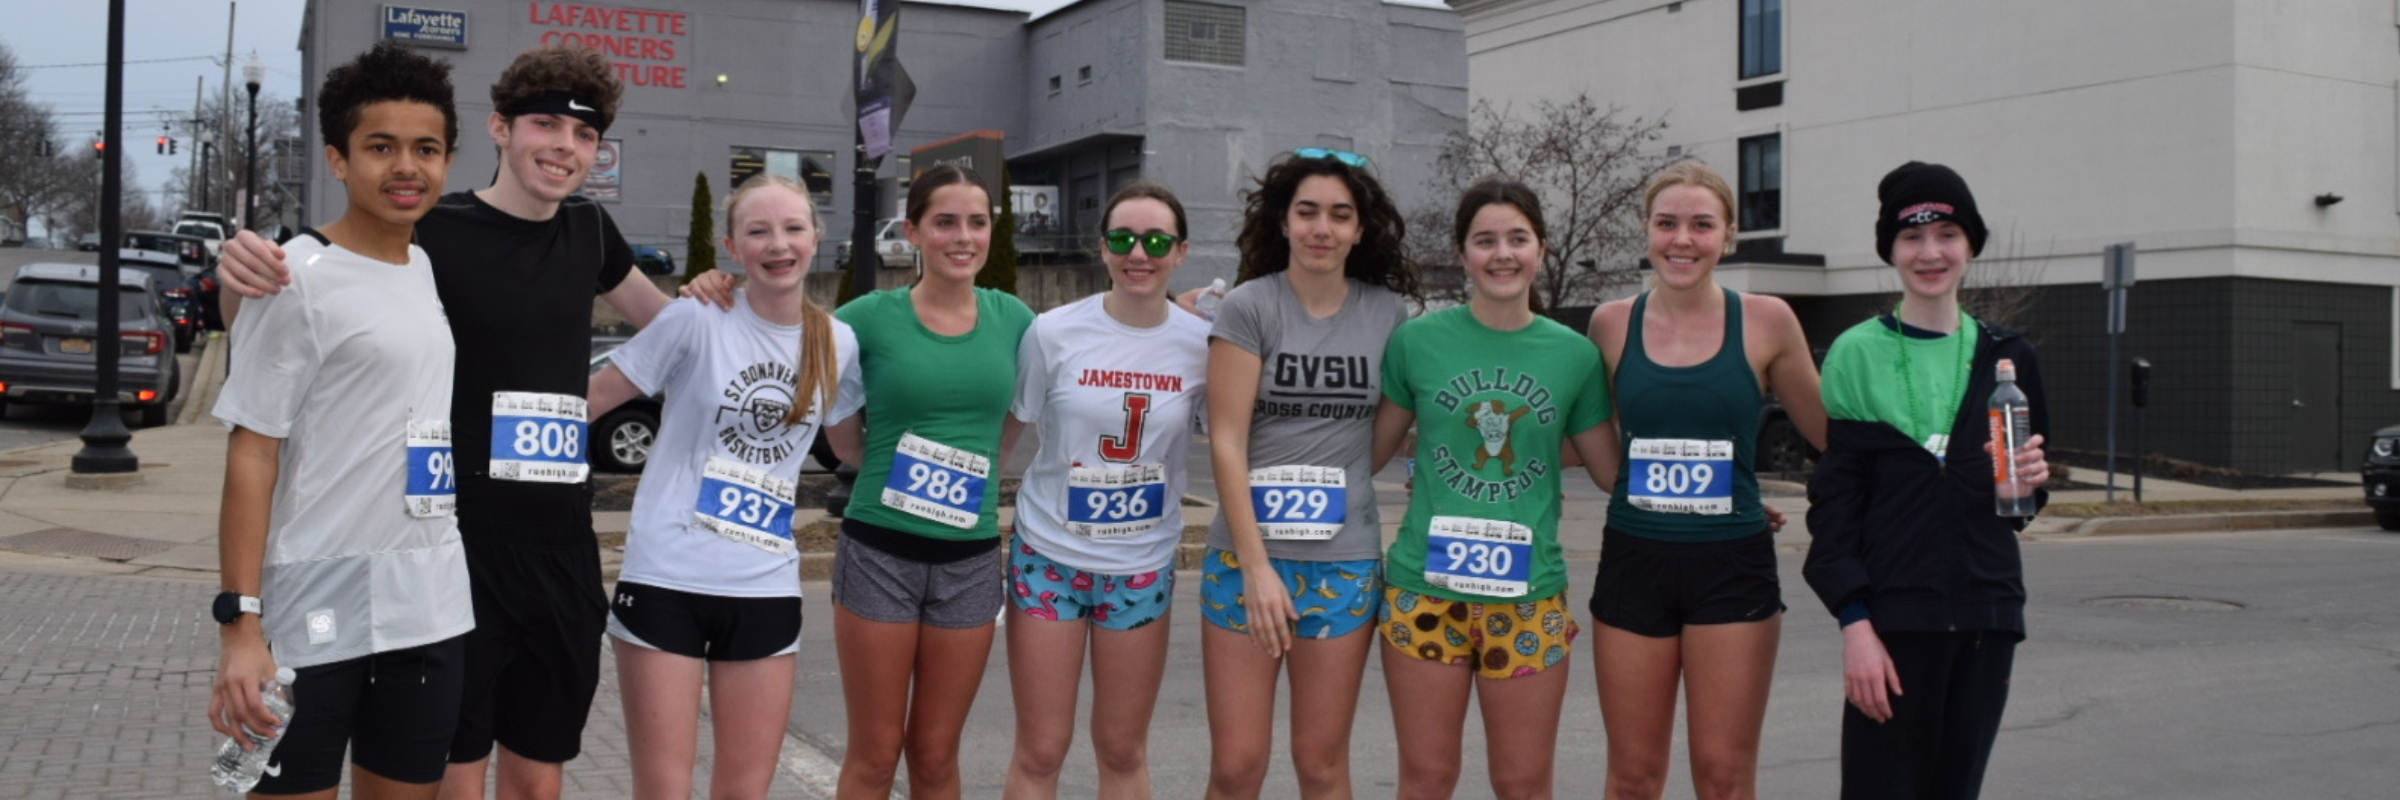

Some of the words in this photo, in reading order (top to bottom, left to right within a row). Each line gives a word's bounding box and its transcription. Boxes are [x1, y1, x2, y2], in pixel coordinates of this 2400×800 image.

[388, 7, 462, 30] Lafayette
[530, 2, 687, 36] LAFAYETTE
[540, 30, 676, 61] CORNERS
[1078, 369, 1183, 392] JAMESTOWN
[1274, 352, 1369, 390] GVSU
[1254, 399, 1303, 418] ROSS
[1435, 367, 1557, 426] BULLDOG
[513, 420, 579, 459] 808
[718, 426, 795, 464] BASKETBALL
[1098, 392, 1151, 464] J
[907, 462, 969, 505] 986
[1433, 446, 1547, 502] STAMPEDE
[1646, 462, 1713, 495] 809
[718, 487, 781, 529] 937
[1087, 488, 1149, 520] 936
[1263, 489, 1328, 520] 929
[1446, 541, 1513, 576] 930
